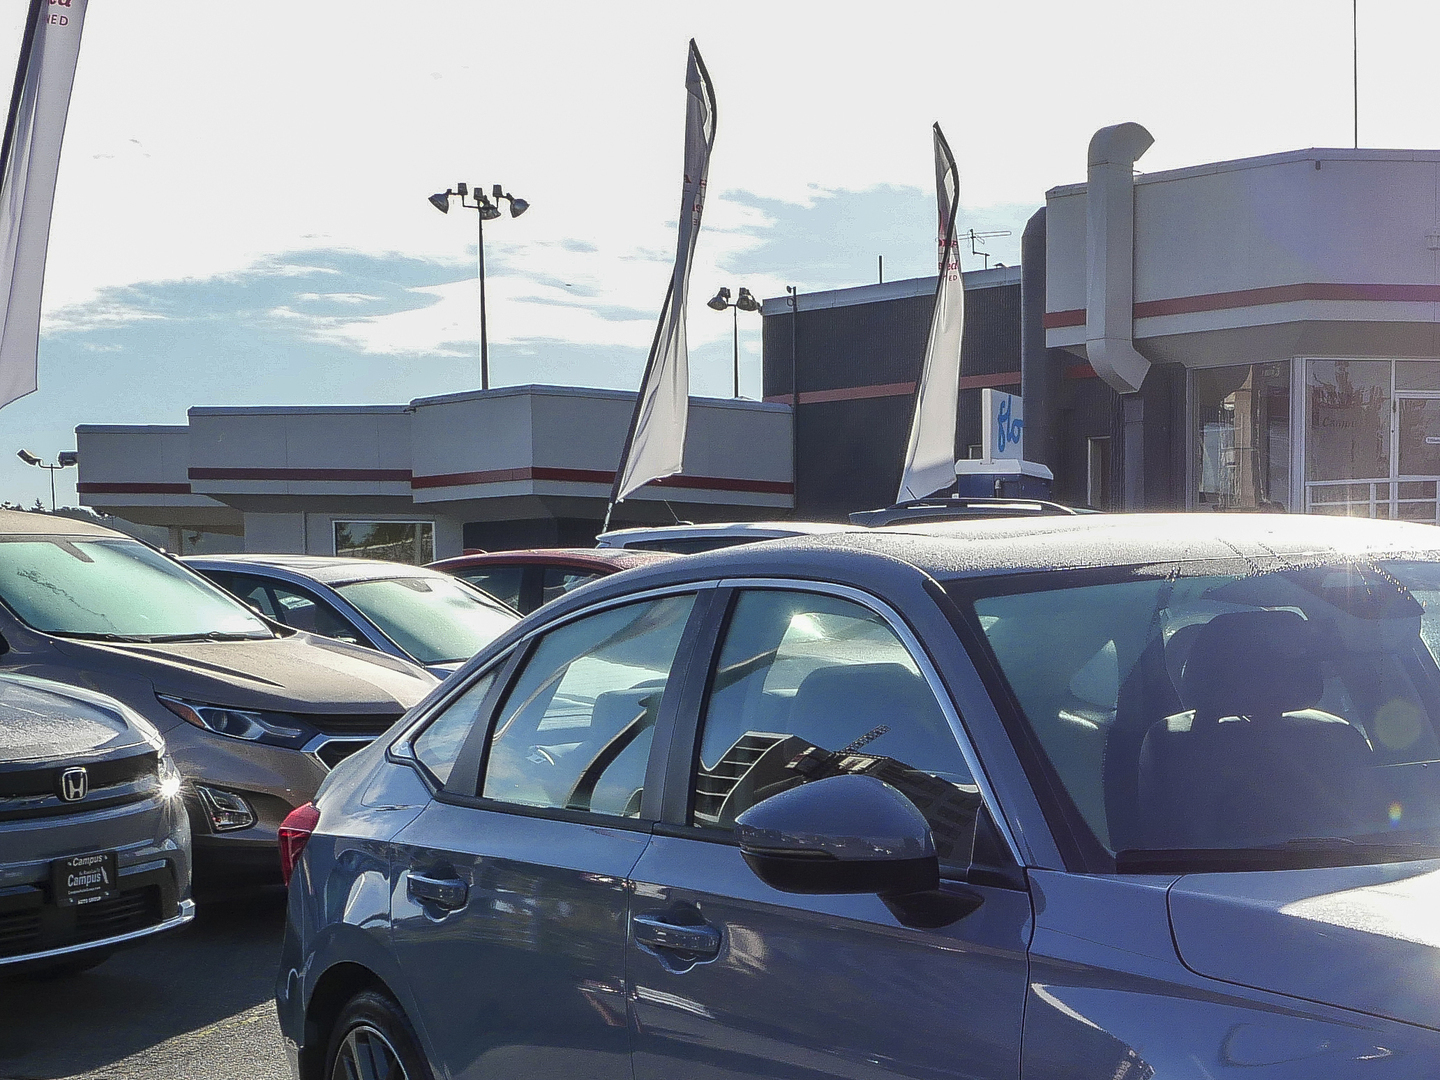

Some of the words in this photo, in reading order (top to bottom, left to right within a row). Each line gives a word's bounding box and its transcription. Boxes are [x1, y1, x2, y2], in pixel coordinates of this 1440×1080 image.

[998, 394, 1024, 453] flo
[72, 855, 103, 867] Campus
[68, 872, 101, 887] Campus
